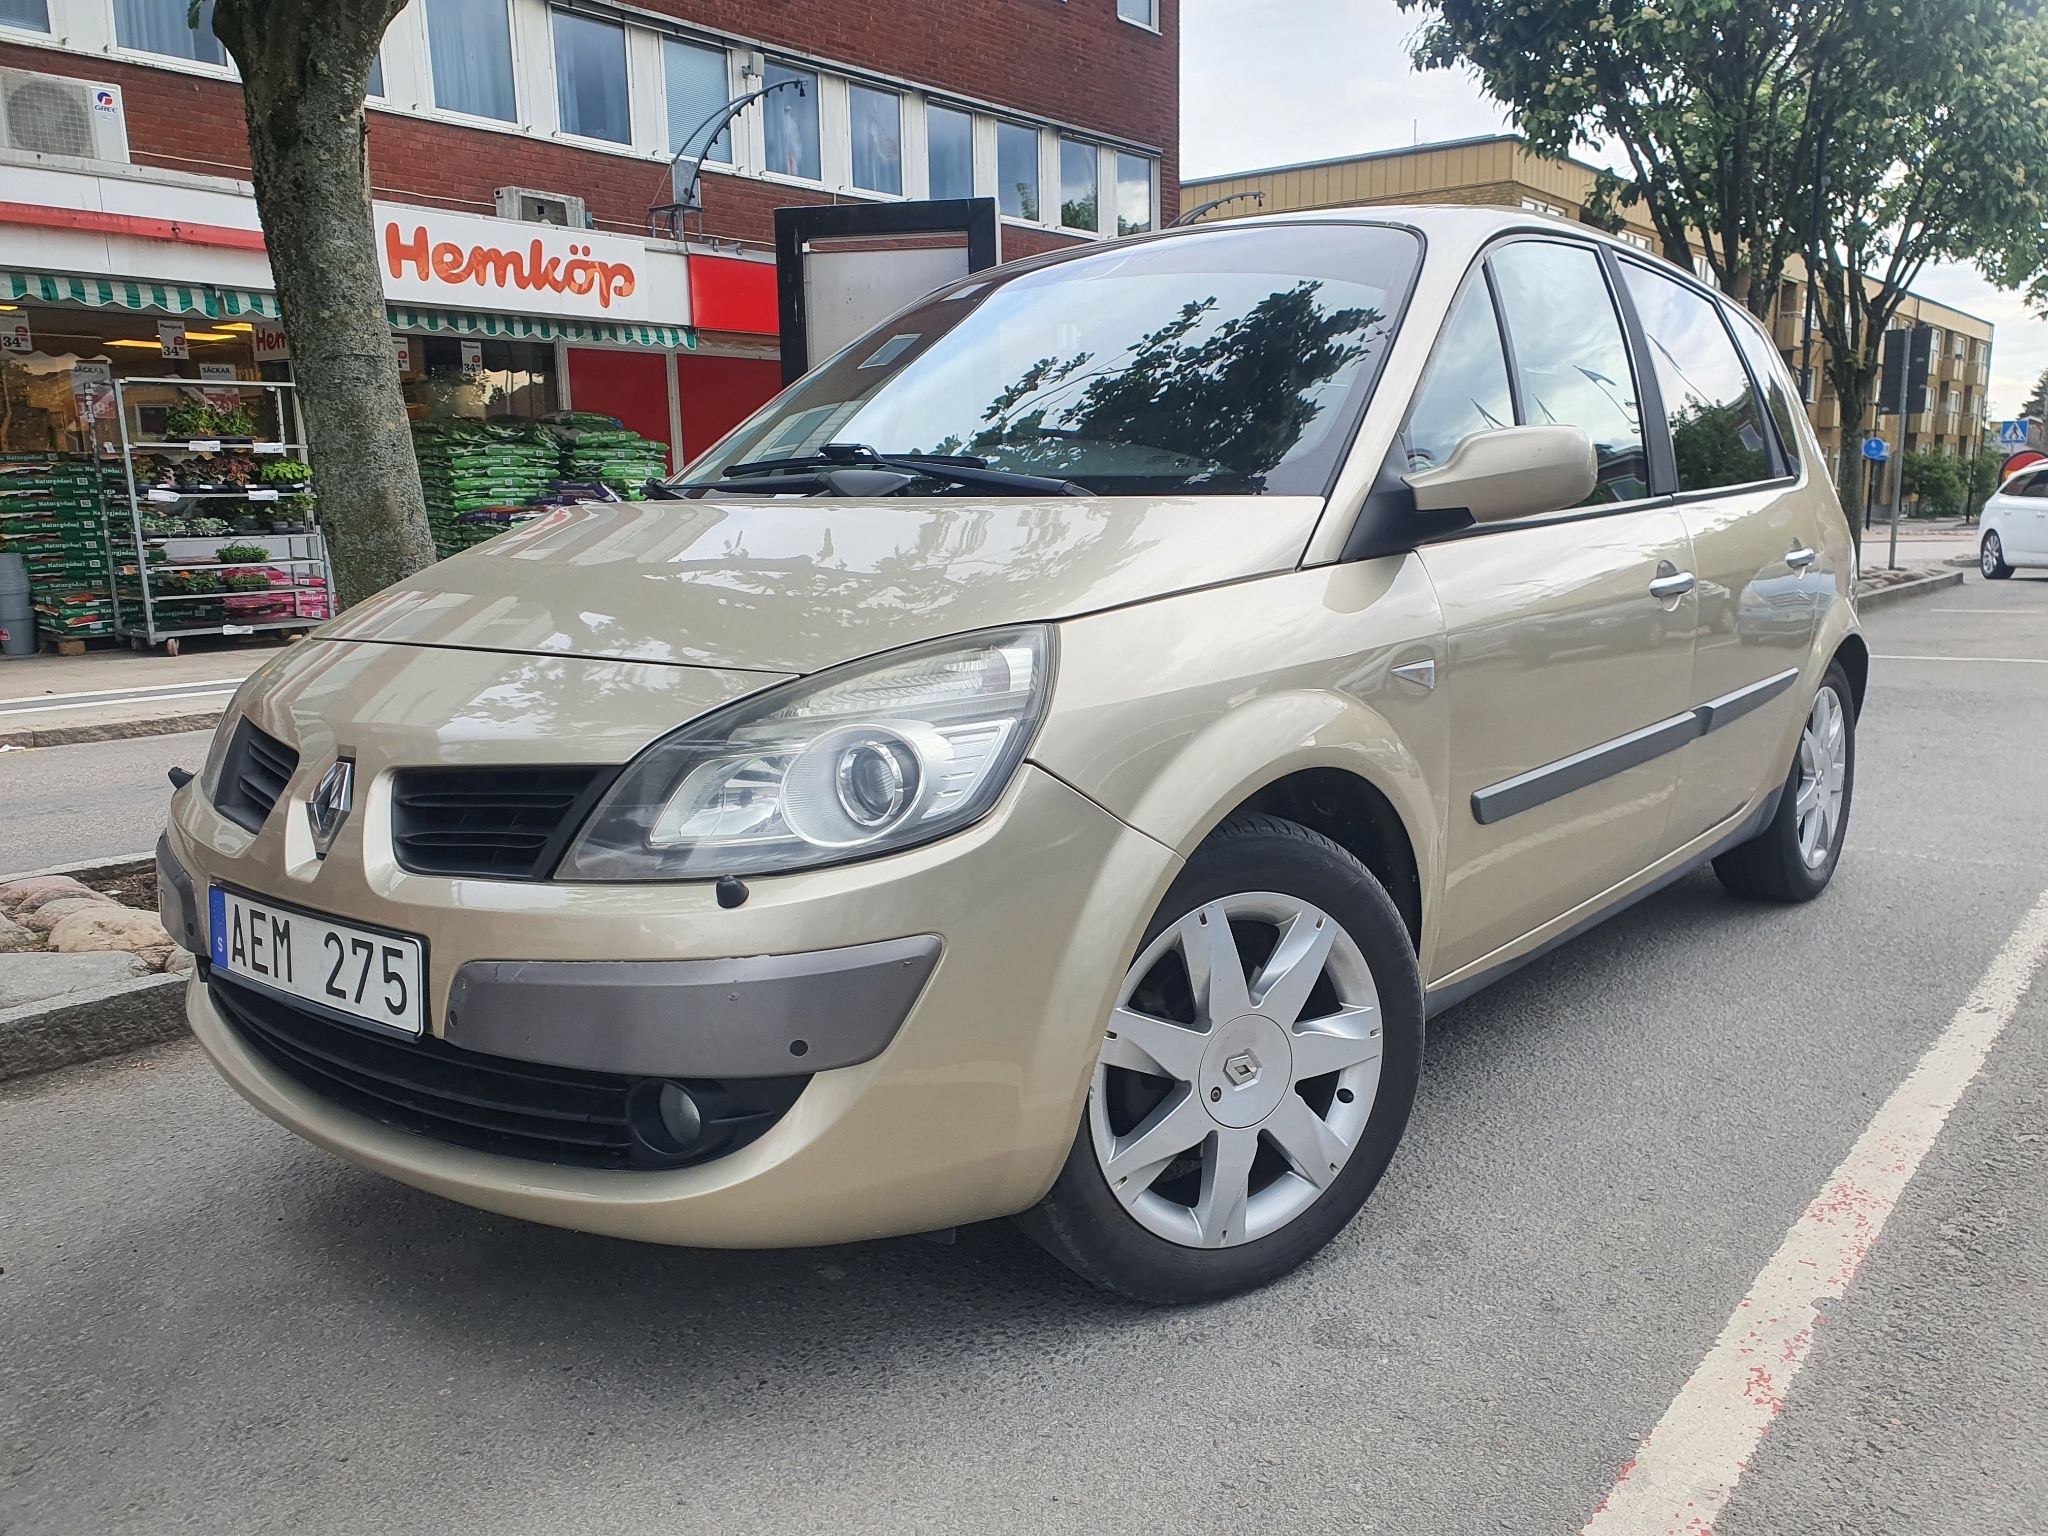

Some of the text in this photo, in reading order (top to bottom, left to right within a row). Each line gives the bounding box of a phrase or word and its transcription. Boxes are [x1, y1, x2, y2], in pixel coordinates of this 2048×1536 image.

[95, 104, 118, 113] GREE
[385, 221, 636, 309] Hemköp
[3, 336, 21, 348] 34
[163, 345, 179, 357] 34
[201, 366, 231, 374] SÄCKAR
[464, 362, 477, 373] 34
[38, 500, 77, 508] Naturgödsel
[41, 521, 80, 529] Naturgödsel
[44, 541, 82, 549] Naturgödsel
[47, 560, 86, 569] Naturgödsel
[217, 936, 224, 953] S
[231, 903, 408, 1016] AEM 275
